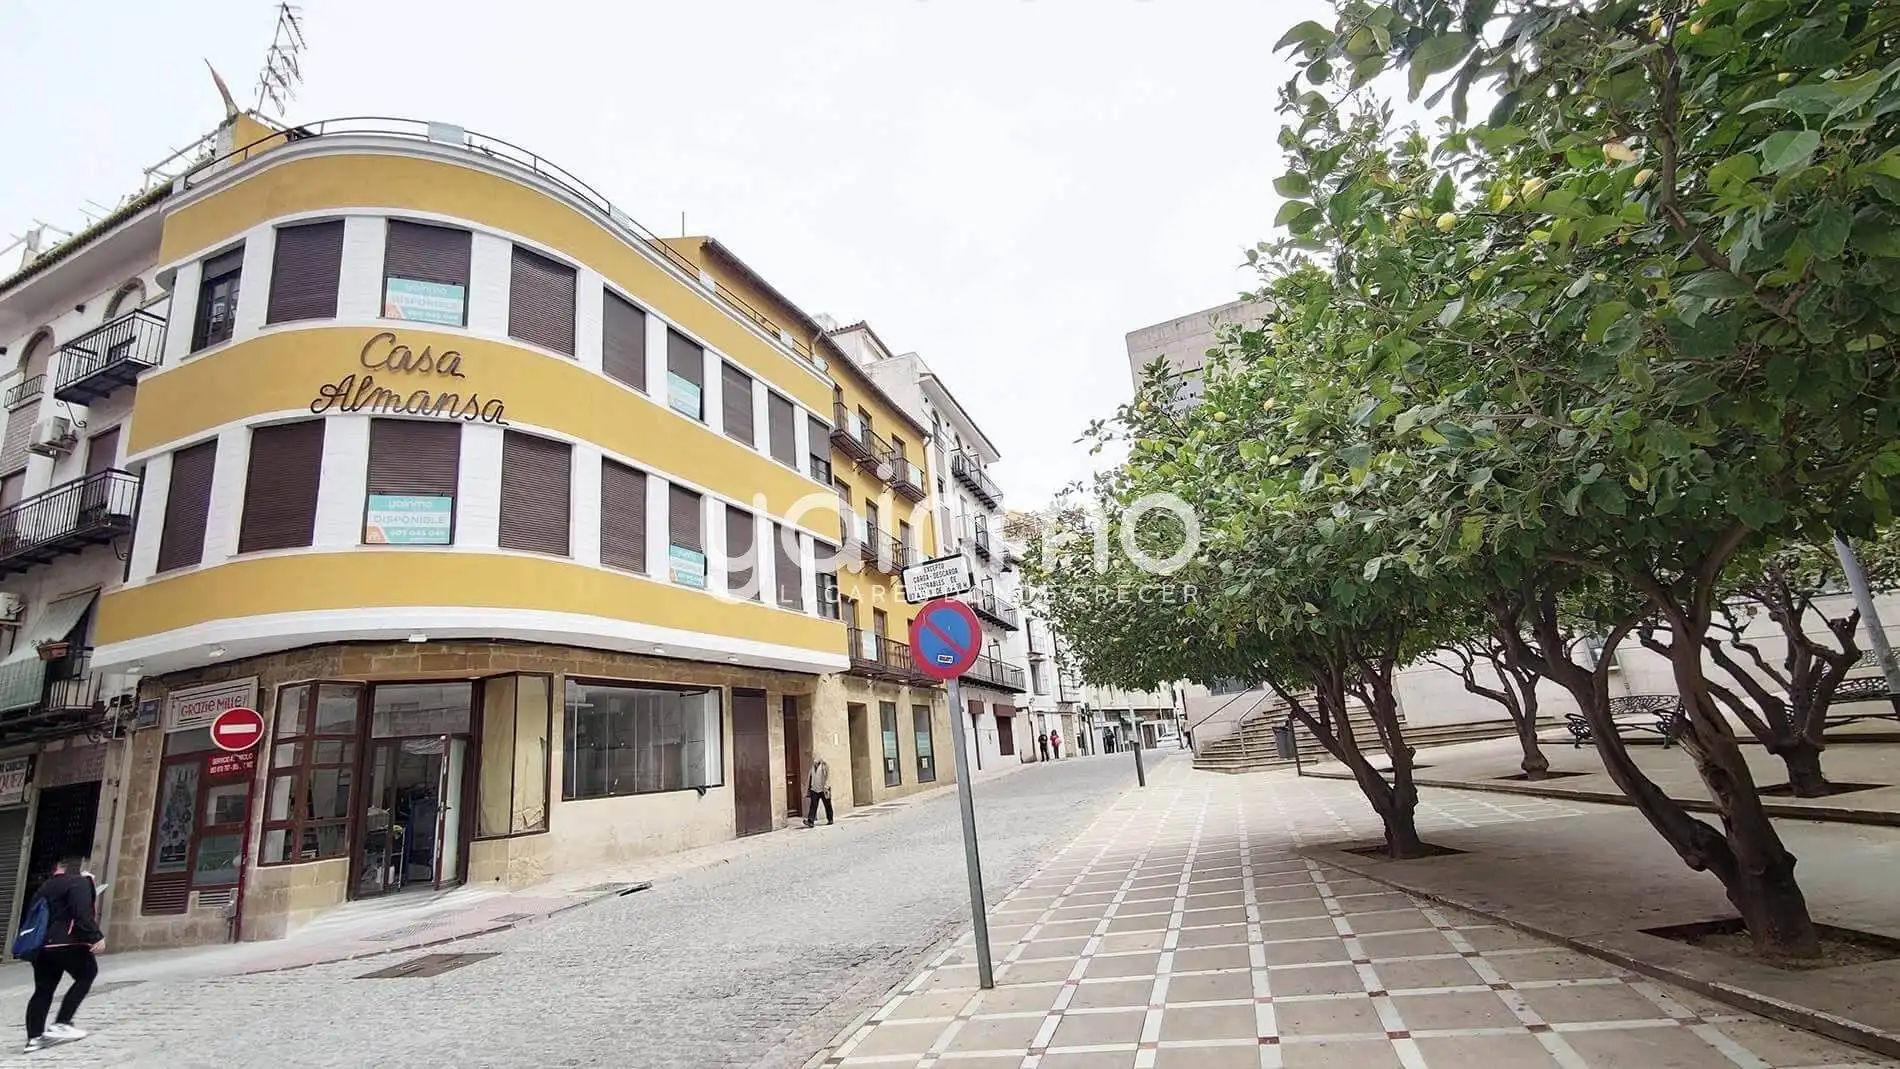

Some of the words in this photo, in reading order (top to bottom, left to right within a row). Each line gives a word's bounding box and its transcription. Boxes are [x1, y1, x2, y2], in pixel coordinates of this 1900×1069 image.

[360, 332, 466, 378] Casa
[310, 374, 510, 426] Almansa
[374, 514, 446, 525] DISPONIBLE
